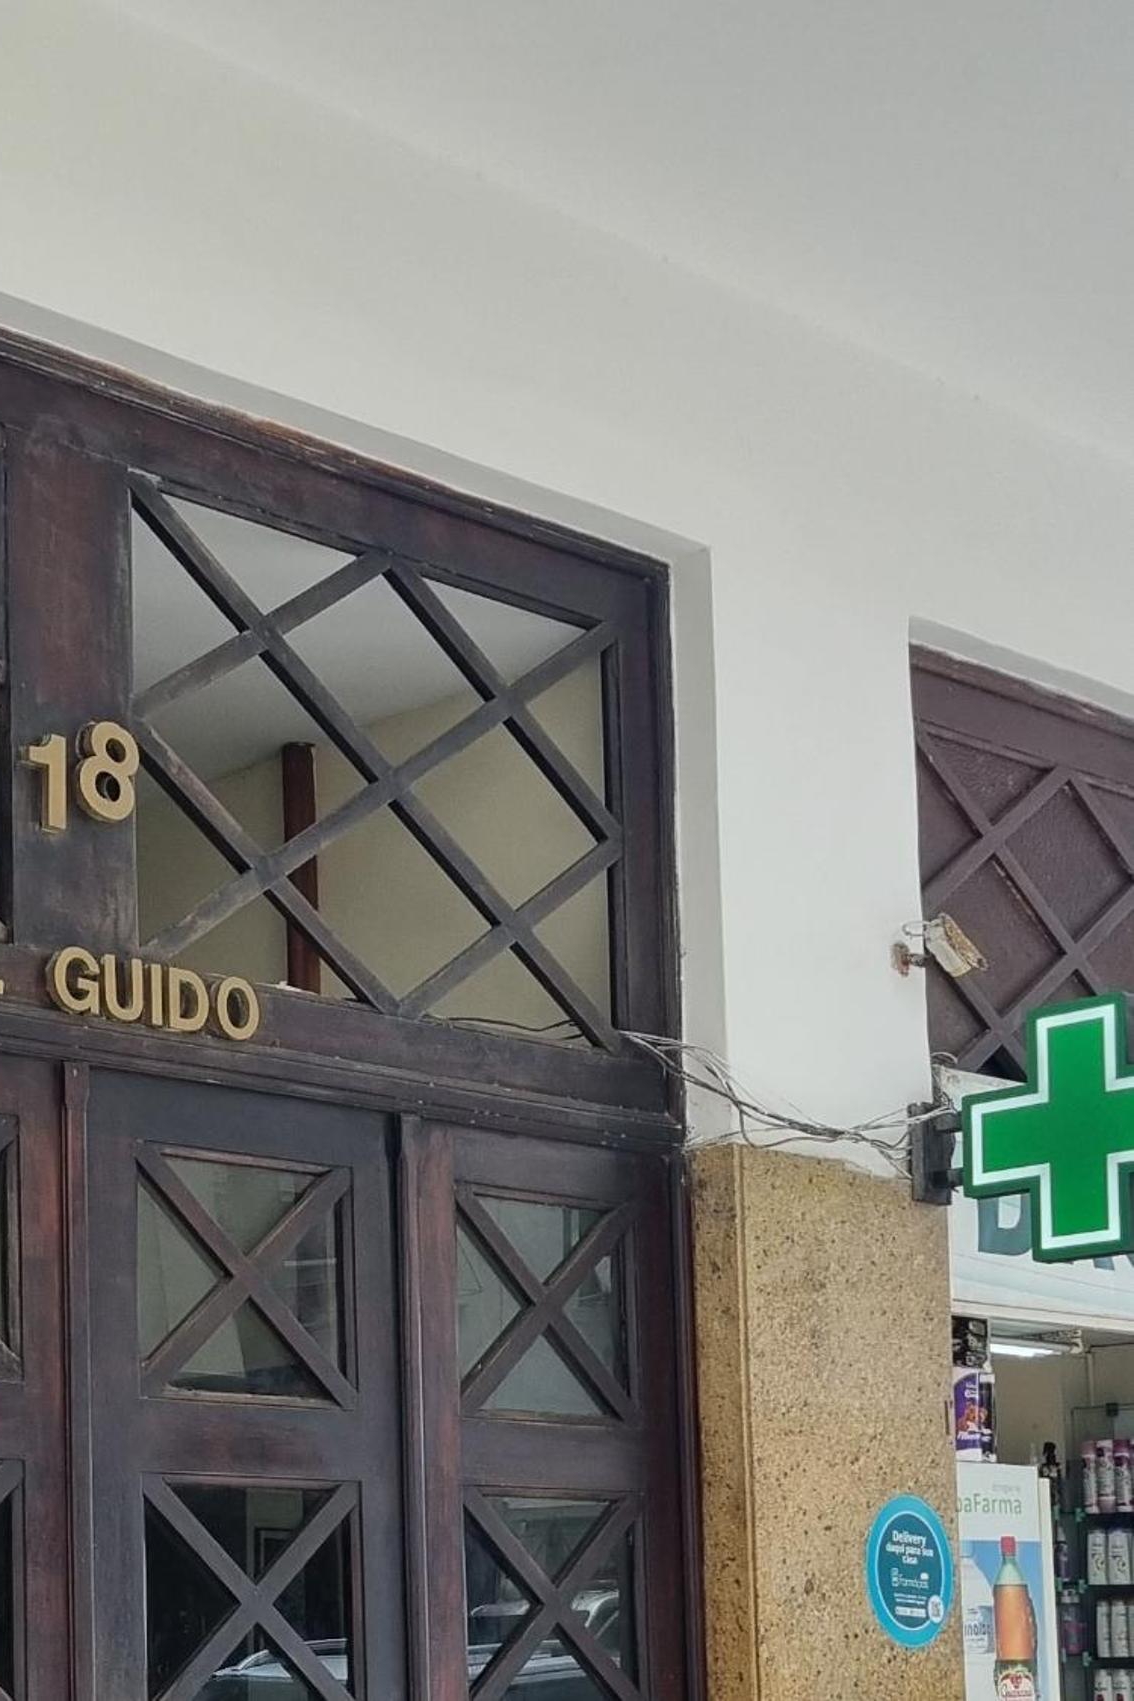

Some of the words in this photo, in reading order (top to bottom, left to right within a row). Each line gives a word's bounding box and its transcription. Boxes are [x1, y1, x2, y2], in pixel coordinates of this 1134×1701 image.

[24, 720, 140, 832] 18
[47, 946, 260, 1041] GUIDO
[892, 1530, 927, 1547] Delivery
